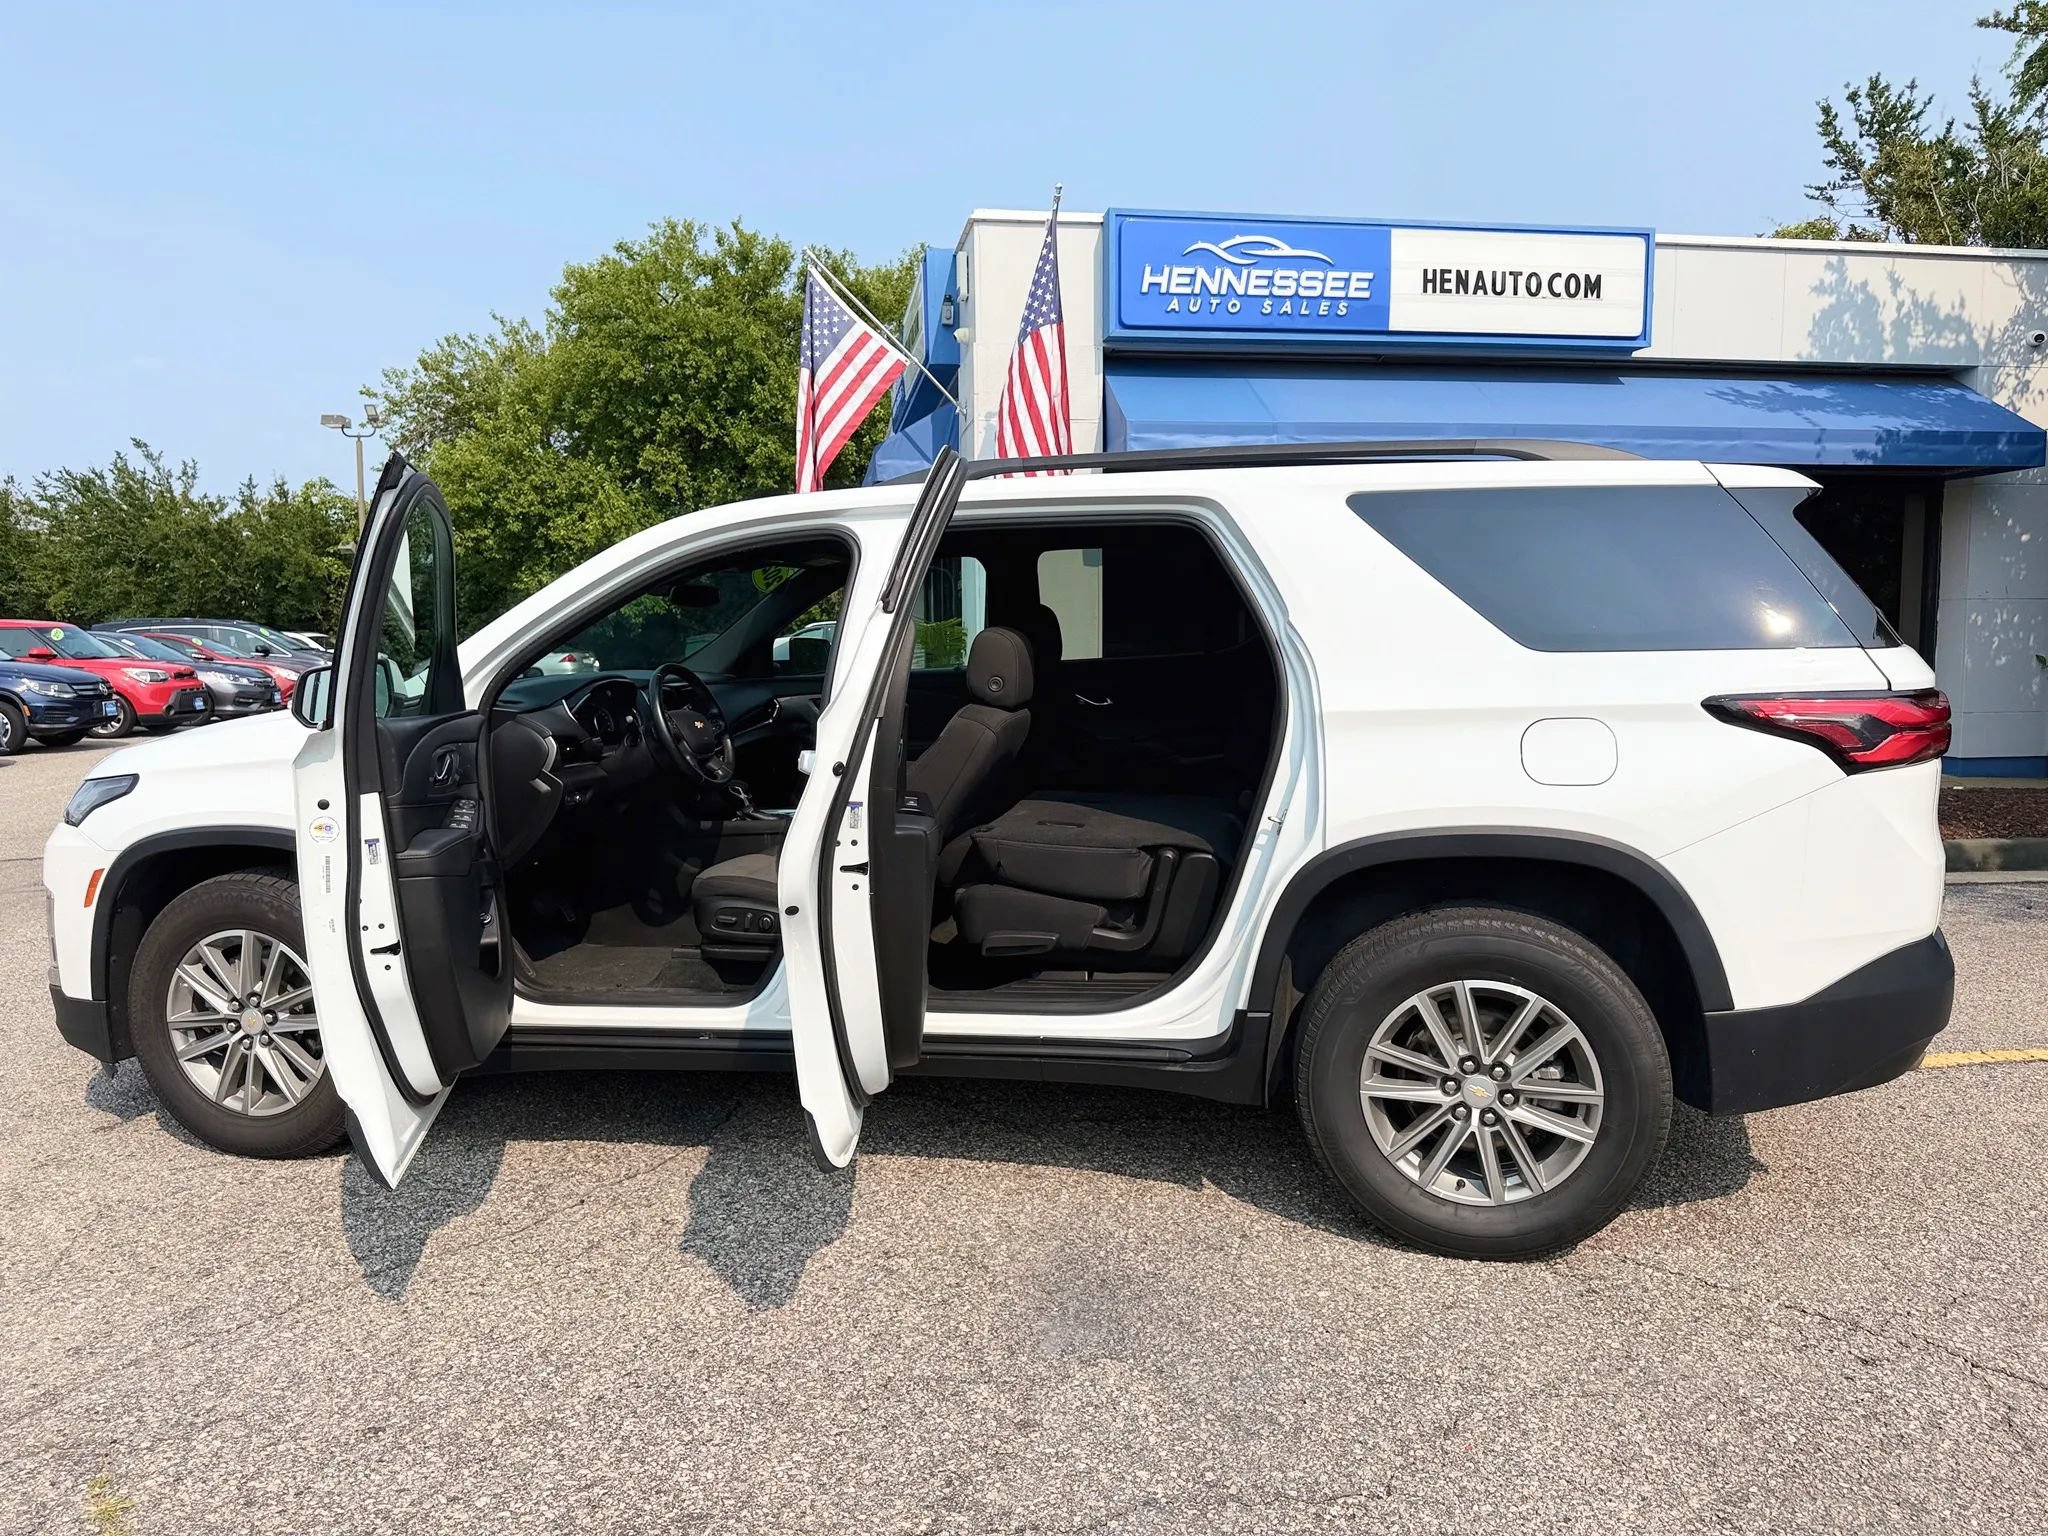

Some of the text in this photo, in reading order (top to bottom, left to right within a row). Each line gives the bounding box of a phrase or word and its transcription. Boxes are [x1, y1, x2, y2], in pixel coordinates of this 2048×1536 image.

[1140, 264, 1374, 298] HENNESSEE
[1166, 297, 1349, 316] AUTO SALES
